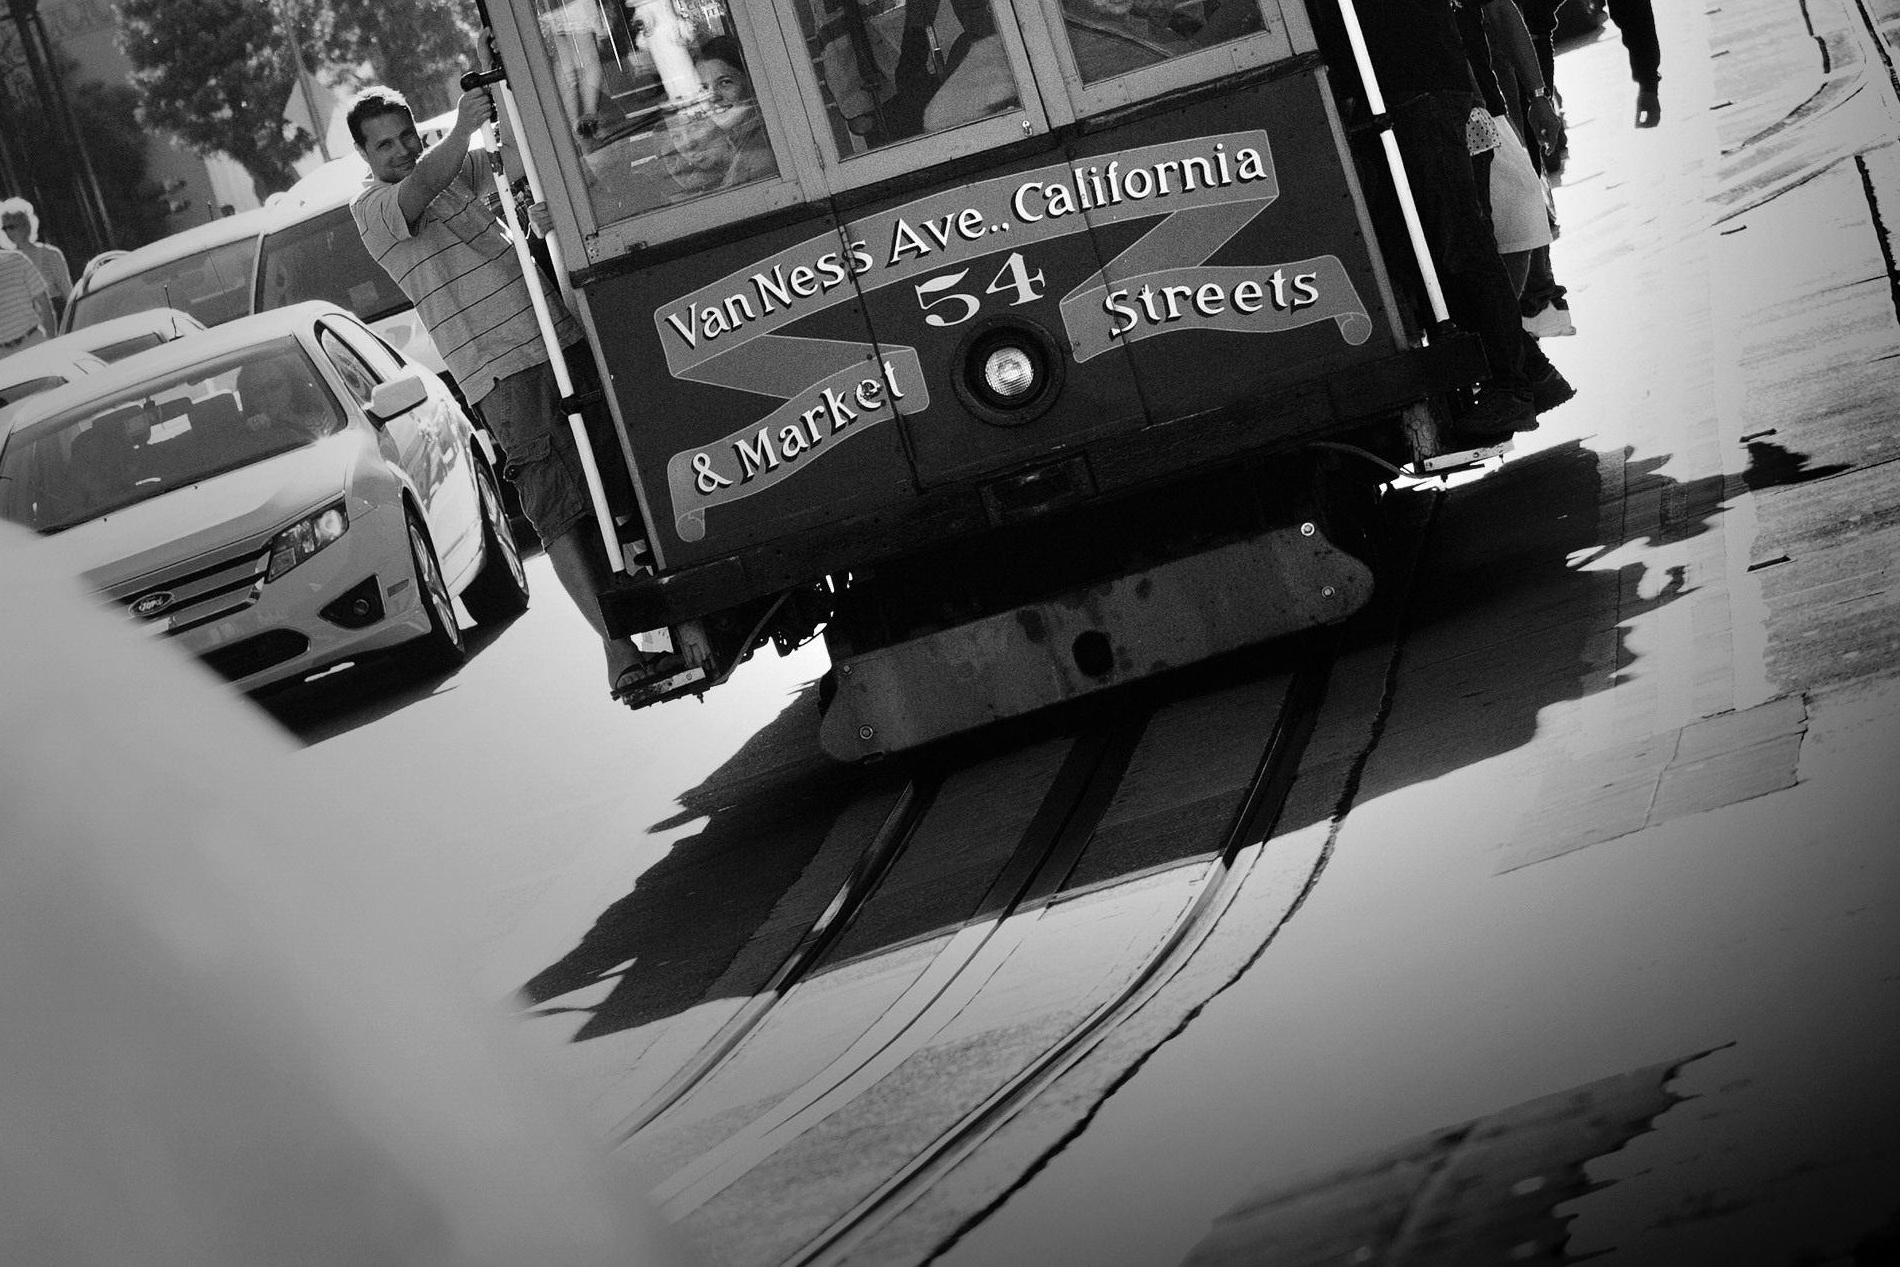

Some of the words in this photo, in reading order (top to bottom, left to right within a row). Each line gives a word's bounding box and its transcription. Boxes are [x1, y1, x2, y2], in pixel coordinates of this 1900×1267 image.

[1012, 142, 1267, 222] California
[914, 252, 1045, 327] 54
[1104, 268, 1318, 338] Streets
[691, 452, 734, 494] &
[732, 360, 904, 482] Market
